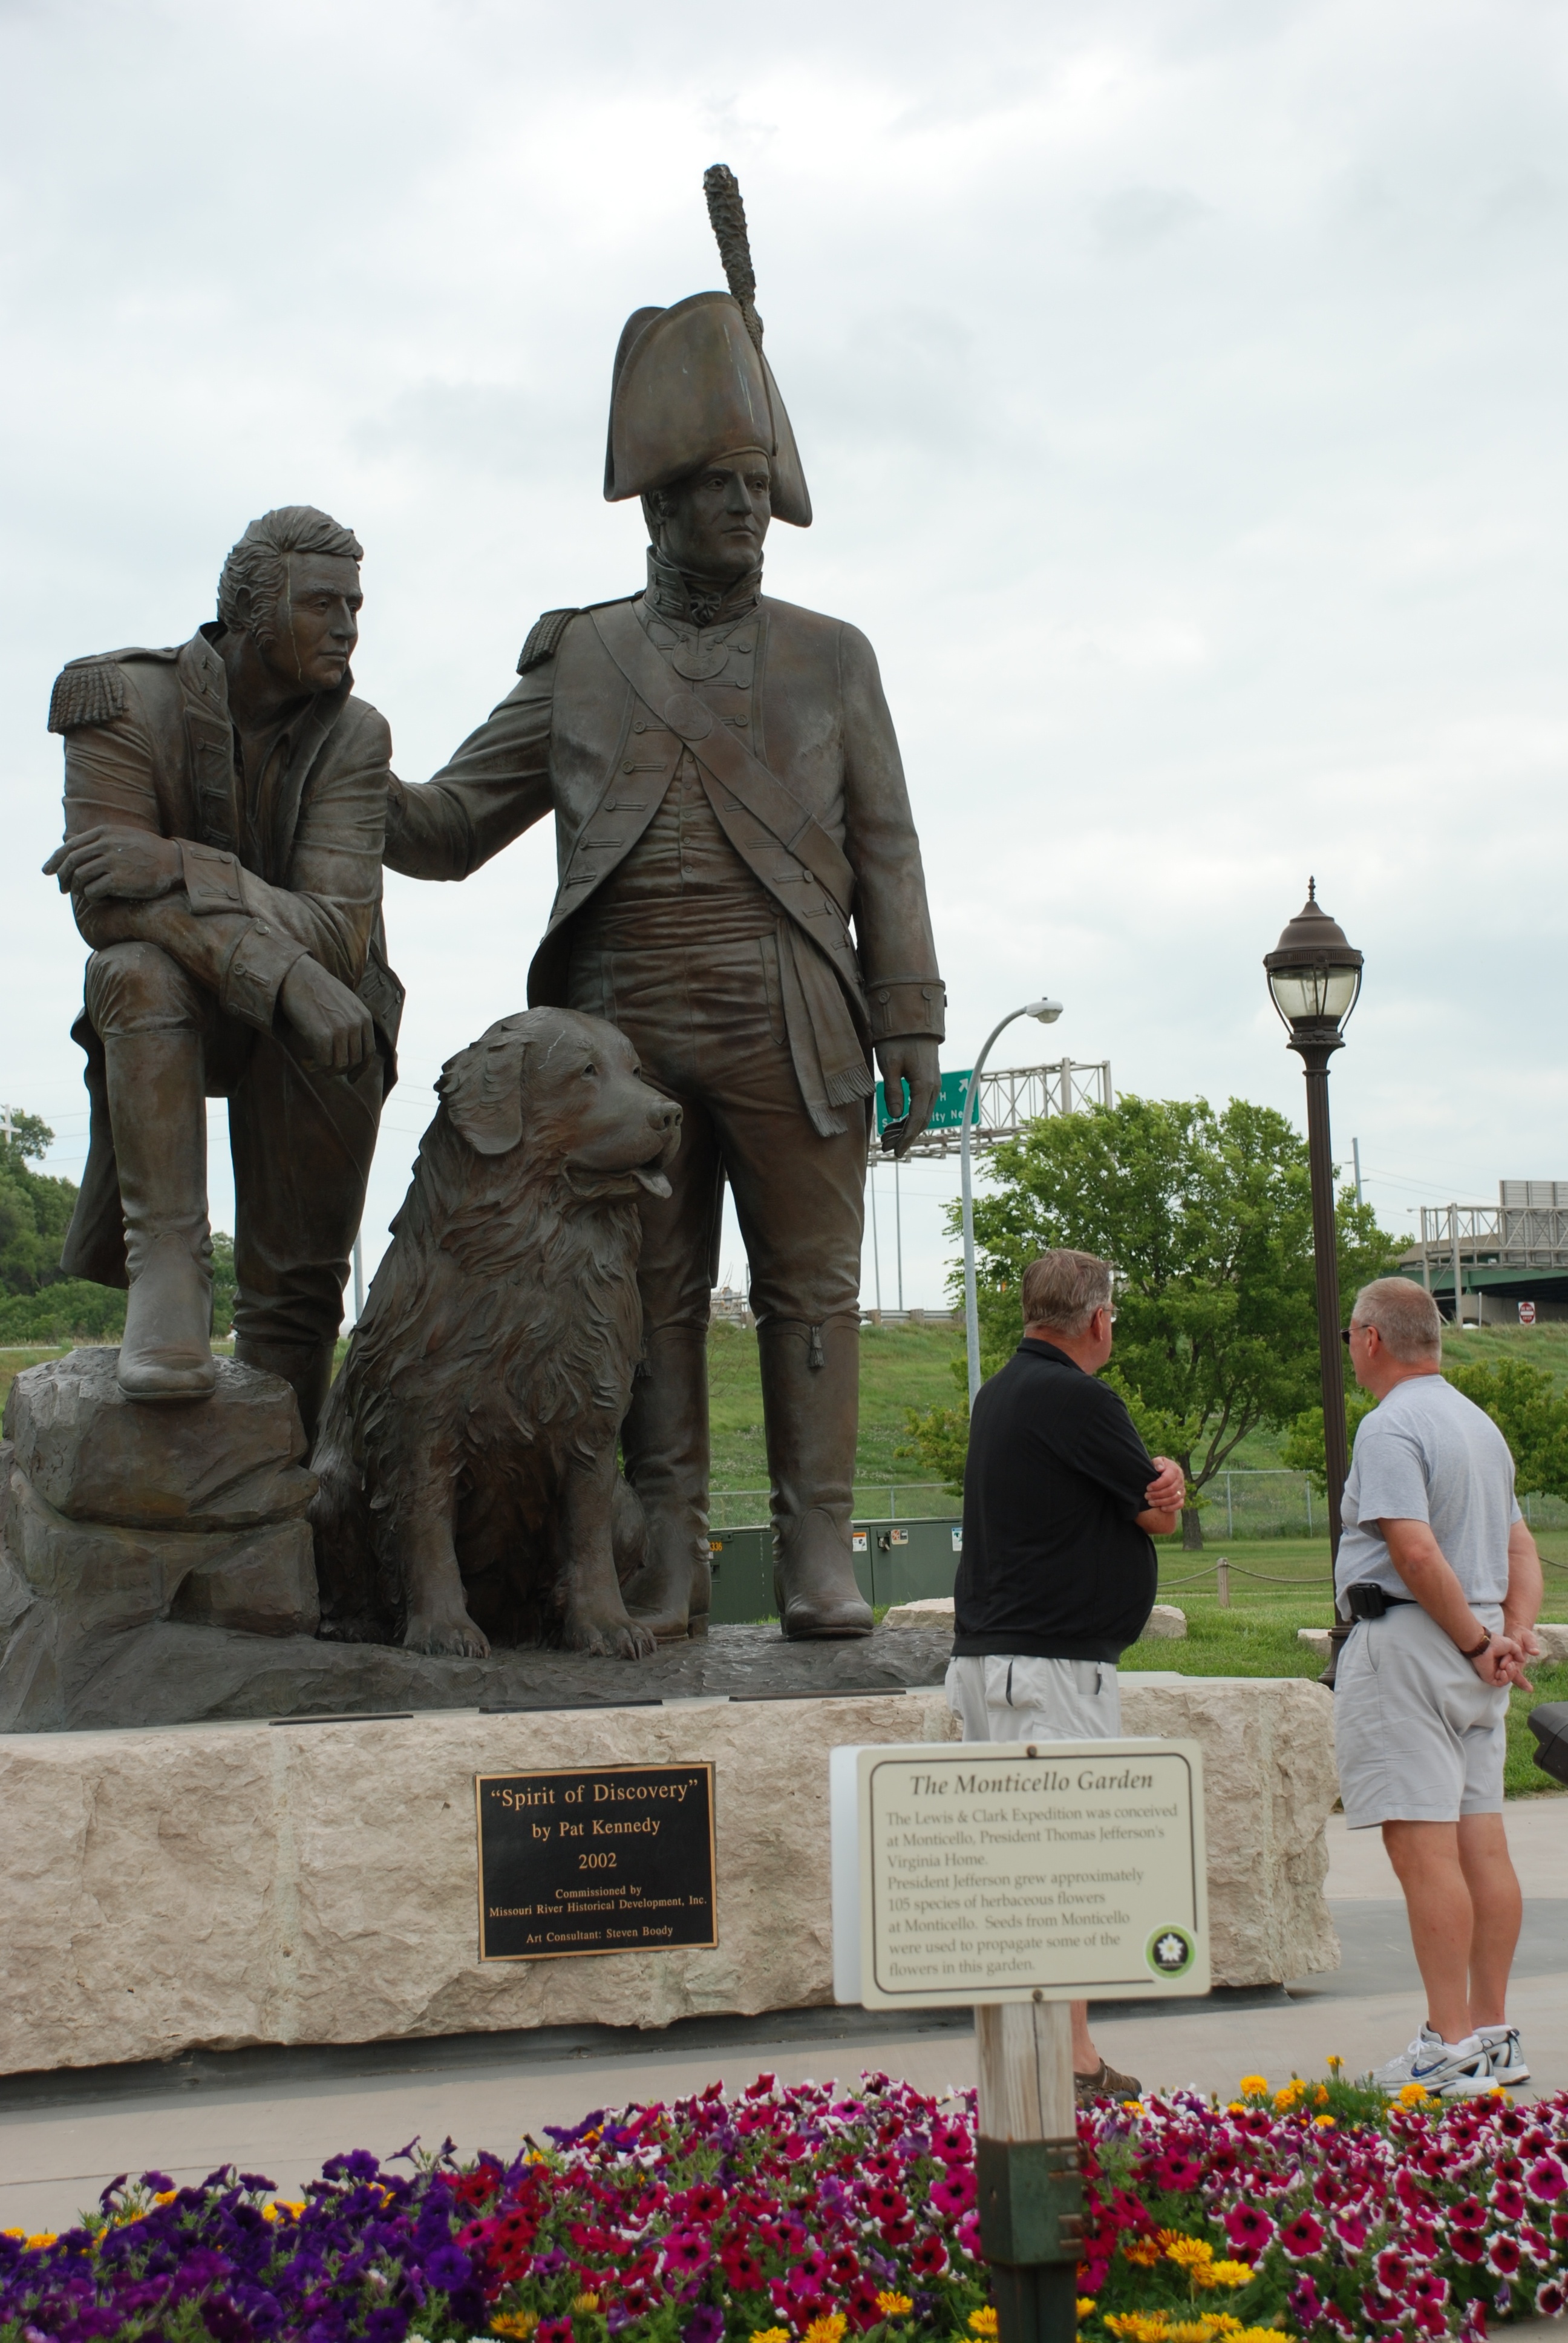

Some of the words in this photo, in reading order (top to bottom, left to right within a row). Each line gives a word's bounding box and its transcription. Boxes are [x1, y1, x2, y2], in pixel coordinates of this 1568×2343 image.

[910, 1775, 948, 1795] The
[955, 1771, 1070, 1794] Monticello
[1077, 1769, 1152, 1791] Garden
[491, 1787, 555, 1811] “Spirit
[564, 1784, 585, 1803] of
[593, 1779, 698, 1802] Discovery”
[886, 1812, 911, 1826] The
[915, 1811, 954, 1825] Lewis
[957, 1810, 968, 1823] &
[972, 1808, 1008, 1823] Clark
[1012, 1807, 1082, 1824] Expedition
[1085, 1808, 1111, 1819] was
[1114, 1803, 1178, 1818] conceived
[532, 1823, 551, 1841] by
[560, 1821, 584, 1837] Pat
[592, 1817, 661, 1835] Kennedy
[886, 1836, 899, 1847] at
[903, 1830, 976, 1846] Monticello,
[980, 1829, 1041, 1844] President
[1045, 1827, 1096, 1841] Thomas
[578, 1852, 617, 1869] 2002
[887, 1855, 941, 1872] Virginia
[944, 1853, 988, 1867] Home.
[888, 1875, 950, 1890] President
[953, 1873, 1011, 1890] Jefferson
[1014, 1874, 1047, 1890] grew
[1050, 1867, 1144, 1888] approximately
[555, 1885, 626, 1899] Commissioned
[630, 1884, 642, 1896] by
[889, 1897, 910, 1912] 105
[914, 1899, 961, 1913] species
[964, 1895, 976, 1909] of
[981, 1893, 1054, 1908] herbaceous
[1057, 1891, 1106, 1905] flowers
[489, 1904, 532, 1918] Missouri
[537, 1904, 563, 1915] River
[567, 1899, 615, 1912] Historical
[619, 1897, 685, 1910] Development,
[689, 1895, 707, 1905] Inc.
[888, 1921, 901, 1933] at
[905, 1916, 978, 1933] Monticello.
[985, 1915, 1023, 1928] Seeds
[1026, 1914, 1058, 1927] from
[1061, 1910, 1130, 1925] Monticello
[526, 1933, 542, 1944] Art
[546, 1930, 601, 1942] Consultant:
[606, 1928, 638, 1938] Steven
[642, 1925, 673, 1937] Boody
[889, 1944, 921, 1955] were
[926, 1938, 956, 1953] used
[961, 1940, 973, 1952] to
[976, 1937, 1043, 1956] propagate
[1046, 1937, 1080, 1948] some
[1084, 1932, 1097, 1946] of
[1100, 1932, 1120, 1946] the
[889, 1962, 938, 1977] flowers
[942, 1961, 955, 1974] in
[959, 1960, 983, 1974] this
[986, 1957, 1035, 1976] garden.
